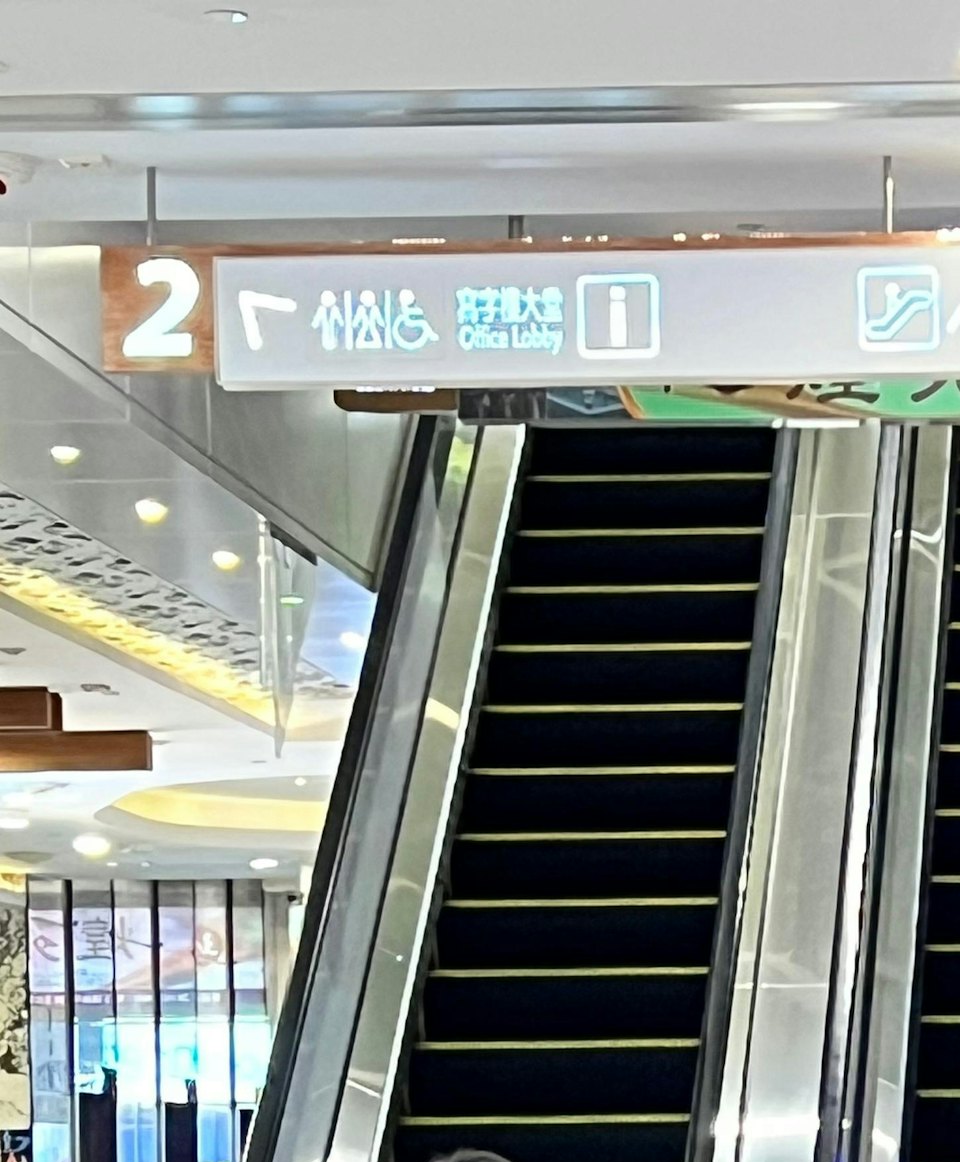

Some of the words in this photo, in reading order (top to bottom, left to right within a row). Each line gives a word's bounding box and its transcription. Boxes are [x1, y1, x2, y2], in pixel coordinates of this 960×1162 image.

[122, 257, 200, 358] 2
[458, 322, 509, 350] Office
[511, 321, 564, 355] Lobby
